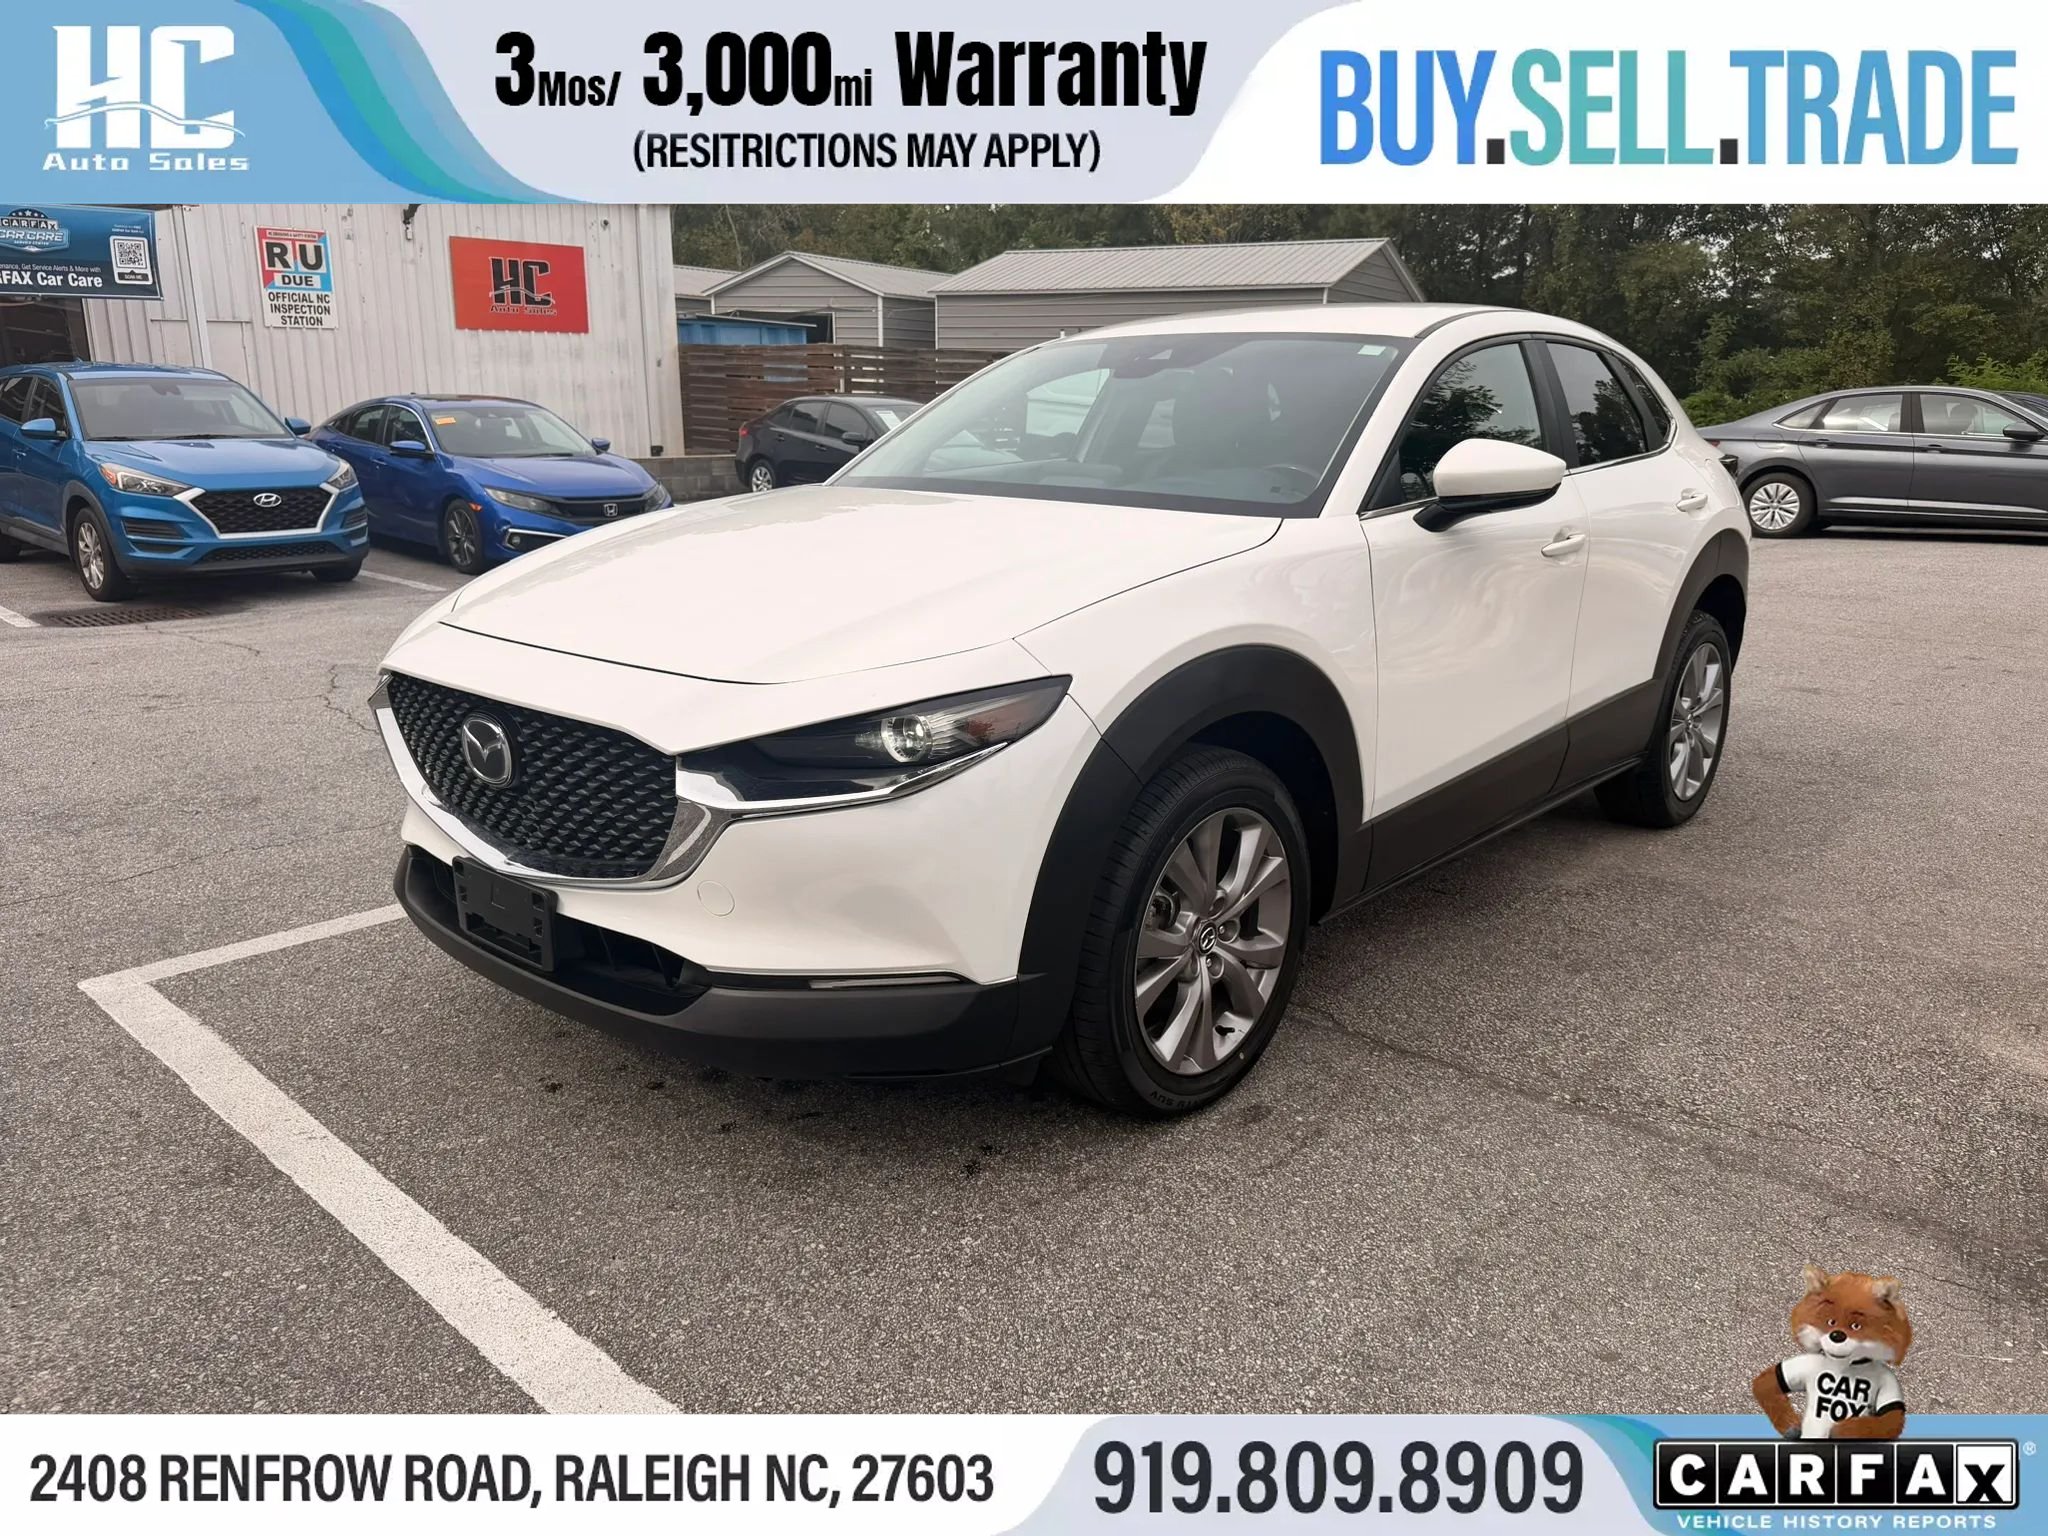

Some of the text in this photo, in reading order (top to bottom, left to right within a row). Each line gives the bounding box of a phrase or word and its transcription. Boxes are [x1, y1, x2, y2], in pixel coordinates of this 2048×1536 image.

[2, 219, 57, 231] CARFAX
[26, 231, 64, 242] CARE
[32, 263, 52, 271] Service
[53, 264, 68, 272] Alerts
[75, 265, 89, 273] More
[0, 270, 103, 288] FAX Car Care
[281, 274, 314, 287] DUE
[489, 257, 553, 307] HC
[268, 291, 331, 304] OFFICIAL NC
[270, 303, 331, 315] INSPECTION
[280, 315, 323, 326] STATION
